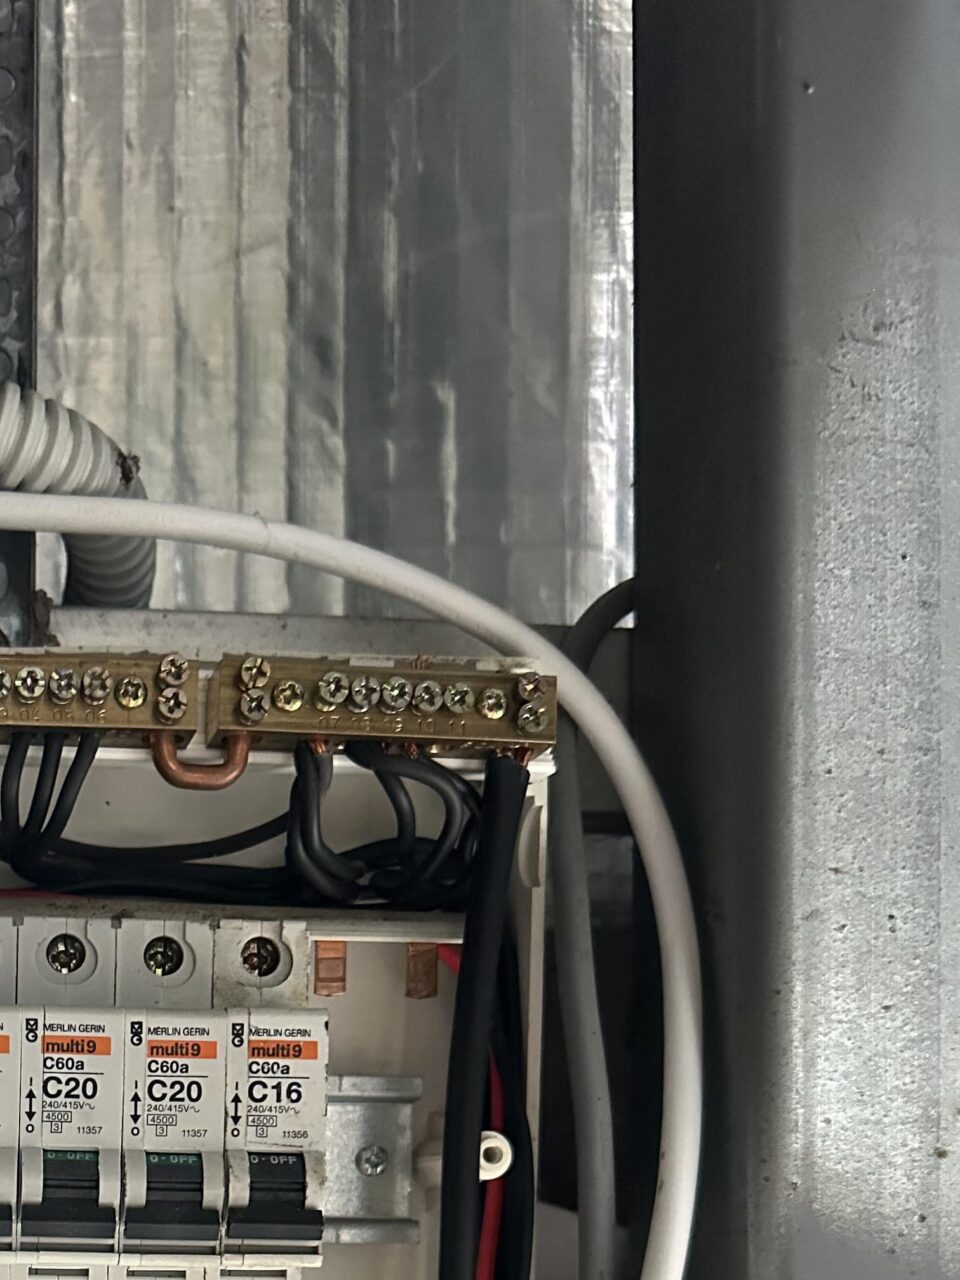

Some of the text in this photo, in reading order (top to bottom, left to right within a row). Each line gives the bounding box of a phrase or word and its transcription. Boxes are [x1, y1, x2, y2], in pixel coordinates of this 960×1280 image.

[44, 1023, 106, 1033] MERLIN GERIN
[148, 1026, 210, 1037] MERLIN GERIN
[249, 1027, 311, 1038] MERLIN GERIN
[42, 1056, 84, 1071] C60a
[147, 1060, 189, 1074] C60a
[248, 1061, 290, 1075] C60a
[42, 1075, 98, 1100] C20
[147, 1079, 203, 1103] C20
[248, 1080, 303, 1104] C16
[45, 1113, 70, 1121] 4500
[150, 1116, 175, 1125] 4500
[250, 1117, 275, 1126] 4500
[77, 1126, 103, 1134] 11357
[182, 1129, 207, 1137] 11357
[281, 1130, 307, 1138] 11356
